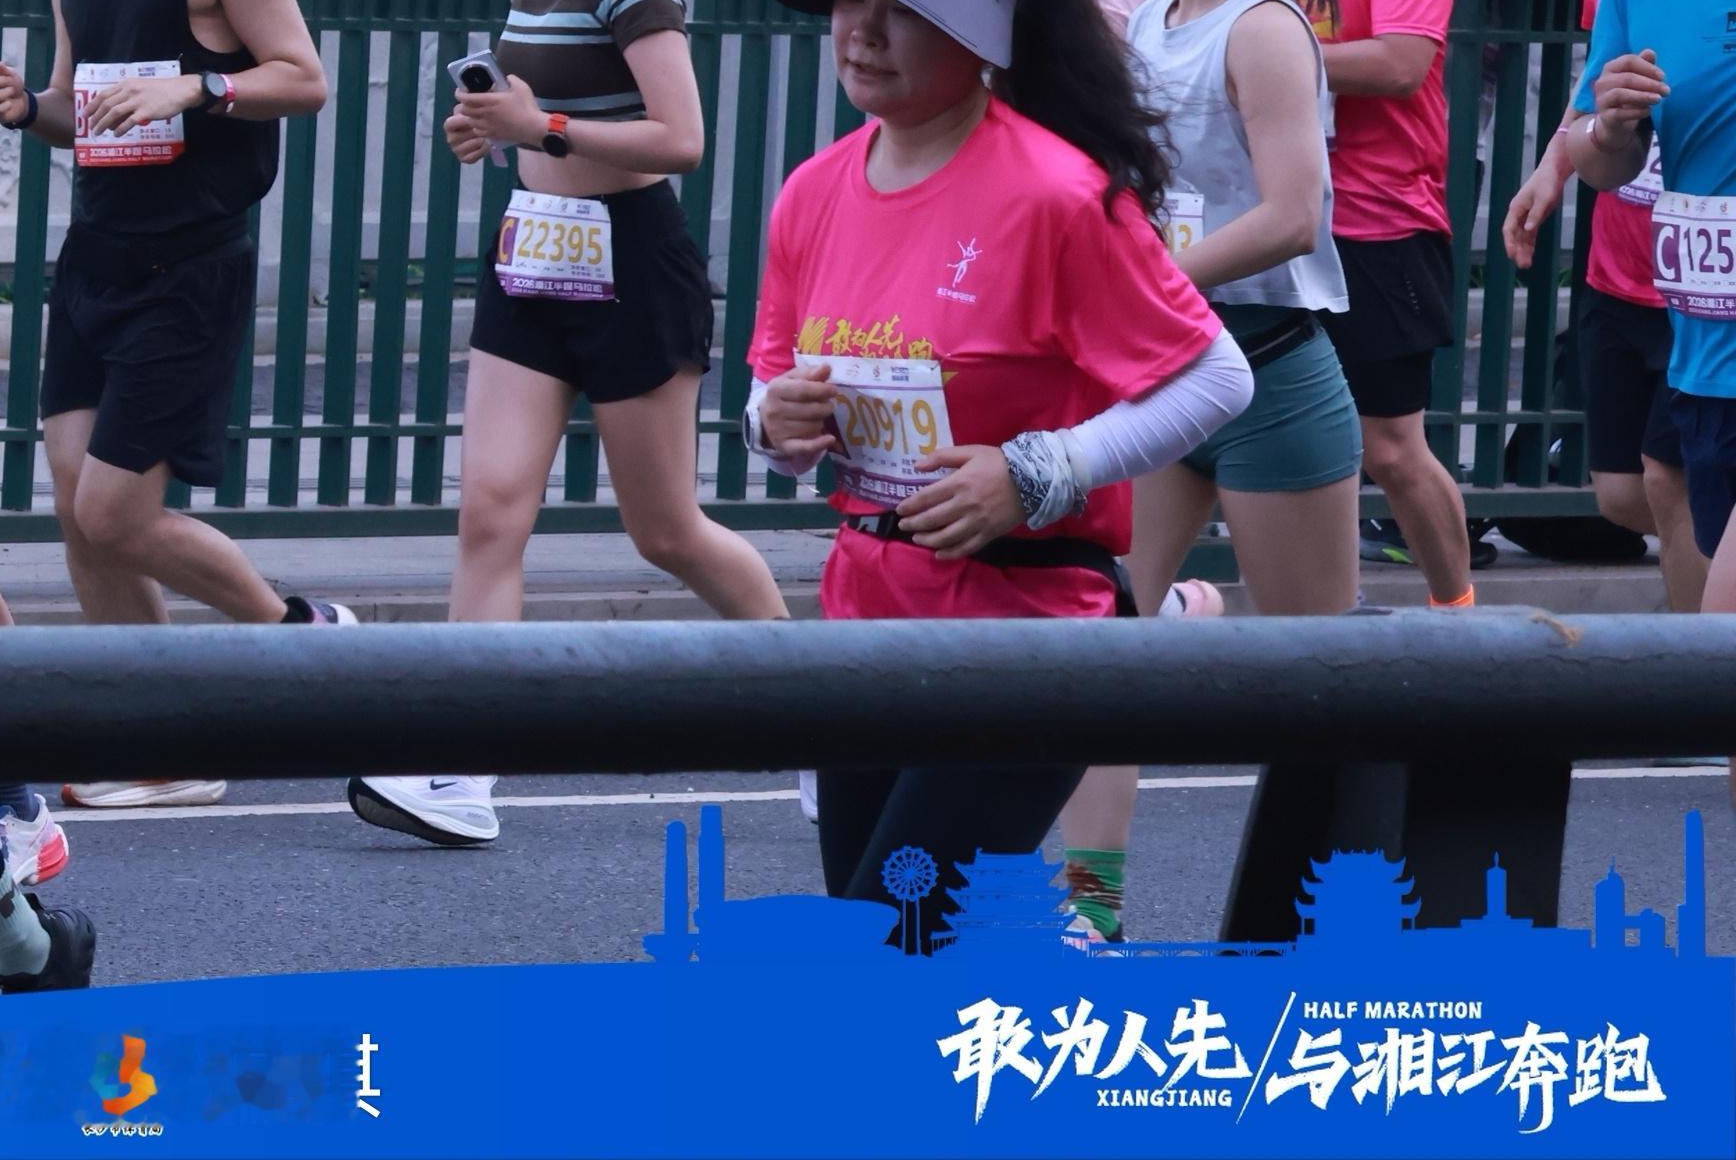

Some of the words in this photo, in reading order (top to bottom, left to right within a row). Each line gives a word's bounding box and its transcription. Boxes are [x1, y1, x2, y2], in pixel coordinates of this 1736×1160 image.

[499, 218, 514, 264] C
[517, 218, 603, 265] 22395
[1656, 225, 1676, 280] C
[834, 392, 938, 455] 20919
